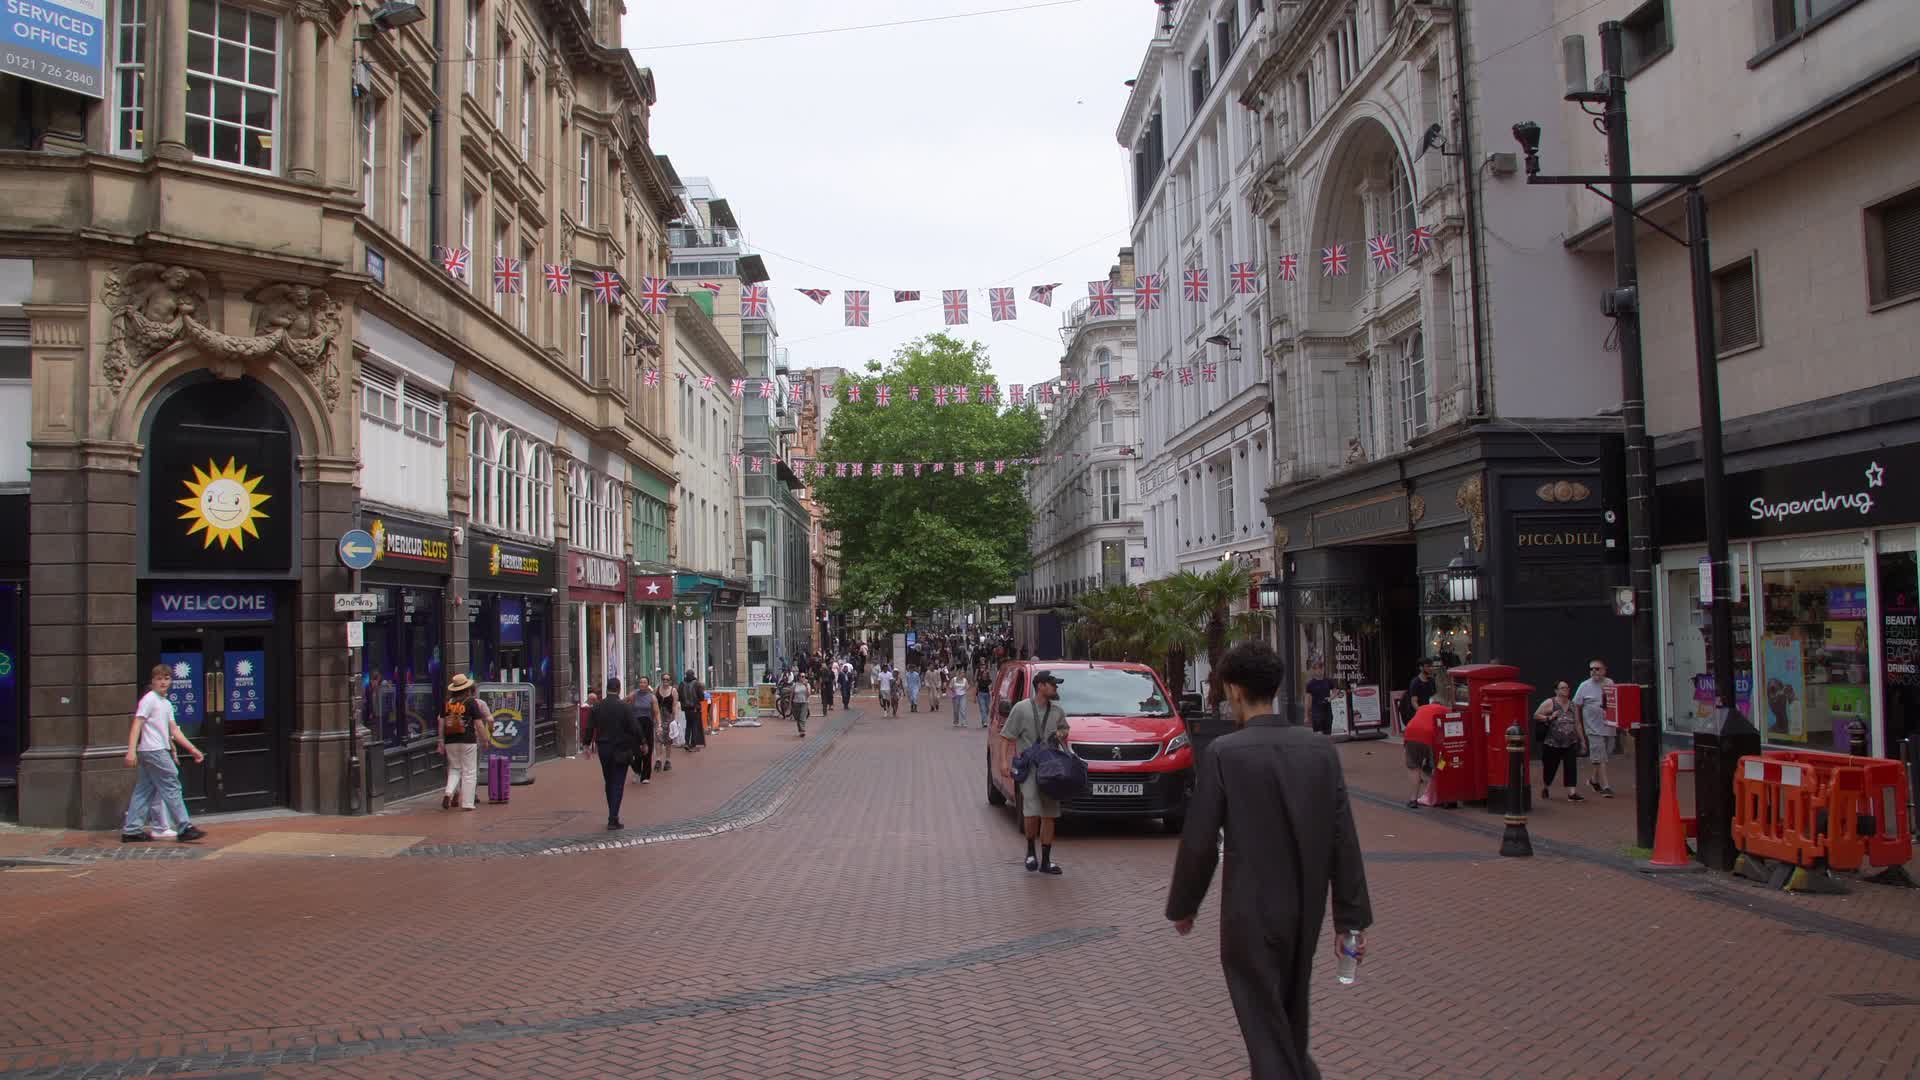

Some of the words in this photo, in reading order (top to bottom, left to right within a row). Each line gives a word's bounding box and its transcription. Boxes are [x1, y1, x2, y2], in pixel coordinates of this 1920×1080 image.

[8, 0, 95, 36] SERVICED
[14, 22, 88, 56] OFFICES
[6, 53, 36, 70] 0121
[40, 62, 62, 78] 726
[65, 69, 94, 86] 2840
[1750, 491, 1874, 521] Superdrug
[387, 533, 422, 556] MERKUR
[422, 540, 449, 559] SLOTS
[1519, 532, 1602, 545] PICCADILL
[501, 553, 522, 570] MERKUR
[523, 557, 539, 573] SLOTS
[160, 595, 266, 611] WELCOME
[338, 598, 355, 607] One
[359, 598, 373, 608] way
[1885, 616, 1917, 625] BEAUTY
[1887, 664, 1916, 673] DRINKS
[492, 720, 518, 737] 24
